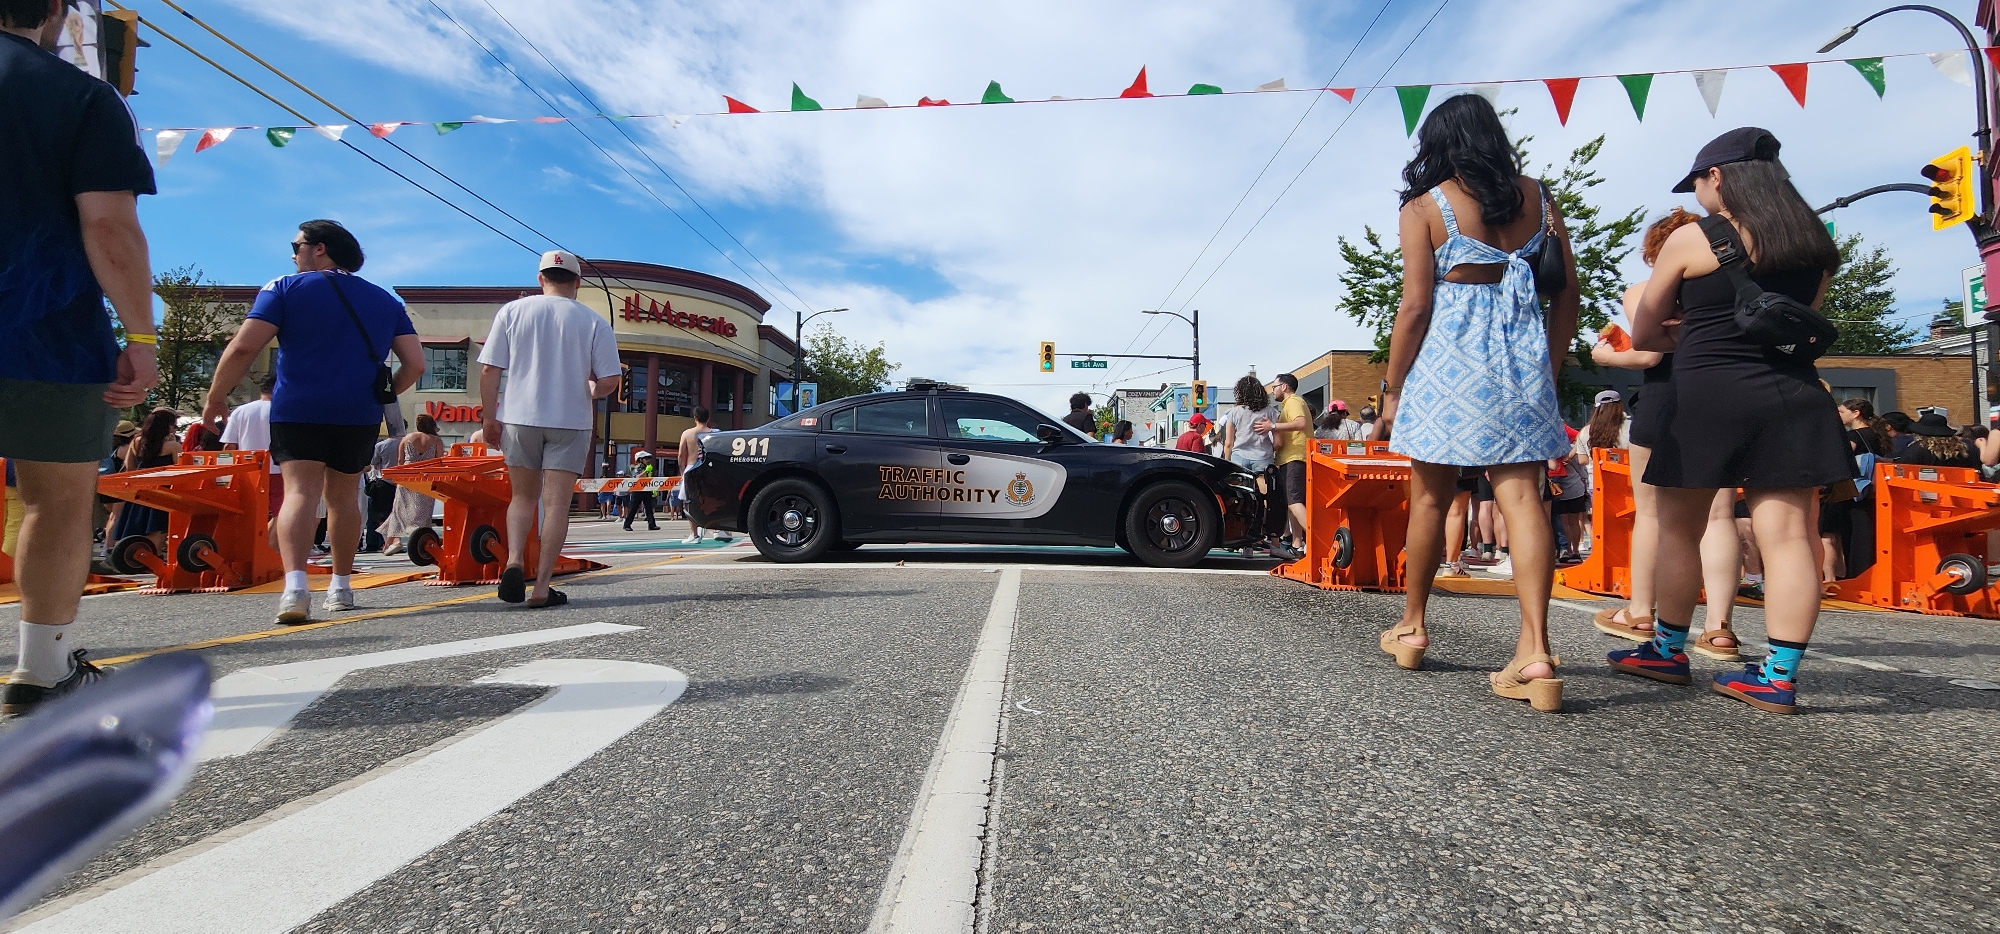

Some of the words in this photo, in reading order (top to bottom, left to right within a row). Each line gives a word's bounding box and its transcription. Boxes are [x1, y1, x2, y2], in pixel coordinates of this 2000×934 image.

[554, 254, 563, 265] LA
[624, 293, 642, 323] Il
[646, 299, 738, 338] Mercato
[731, 437, 770, 456] 911
[607, 481, 625, 489] CITY
[627, 480, 638, 488] OF
[639, 479, 681, 488] VANCOUVE
[879, 465, 966, 485] TRAFFIC
[878, 483, 1001, 504] AUTHORITY
